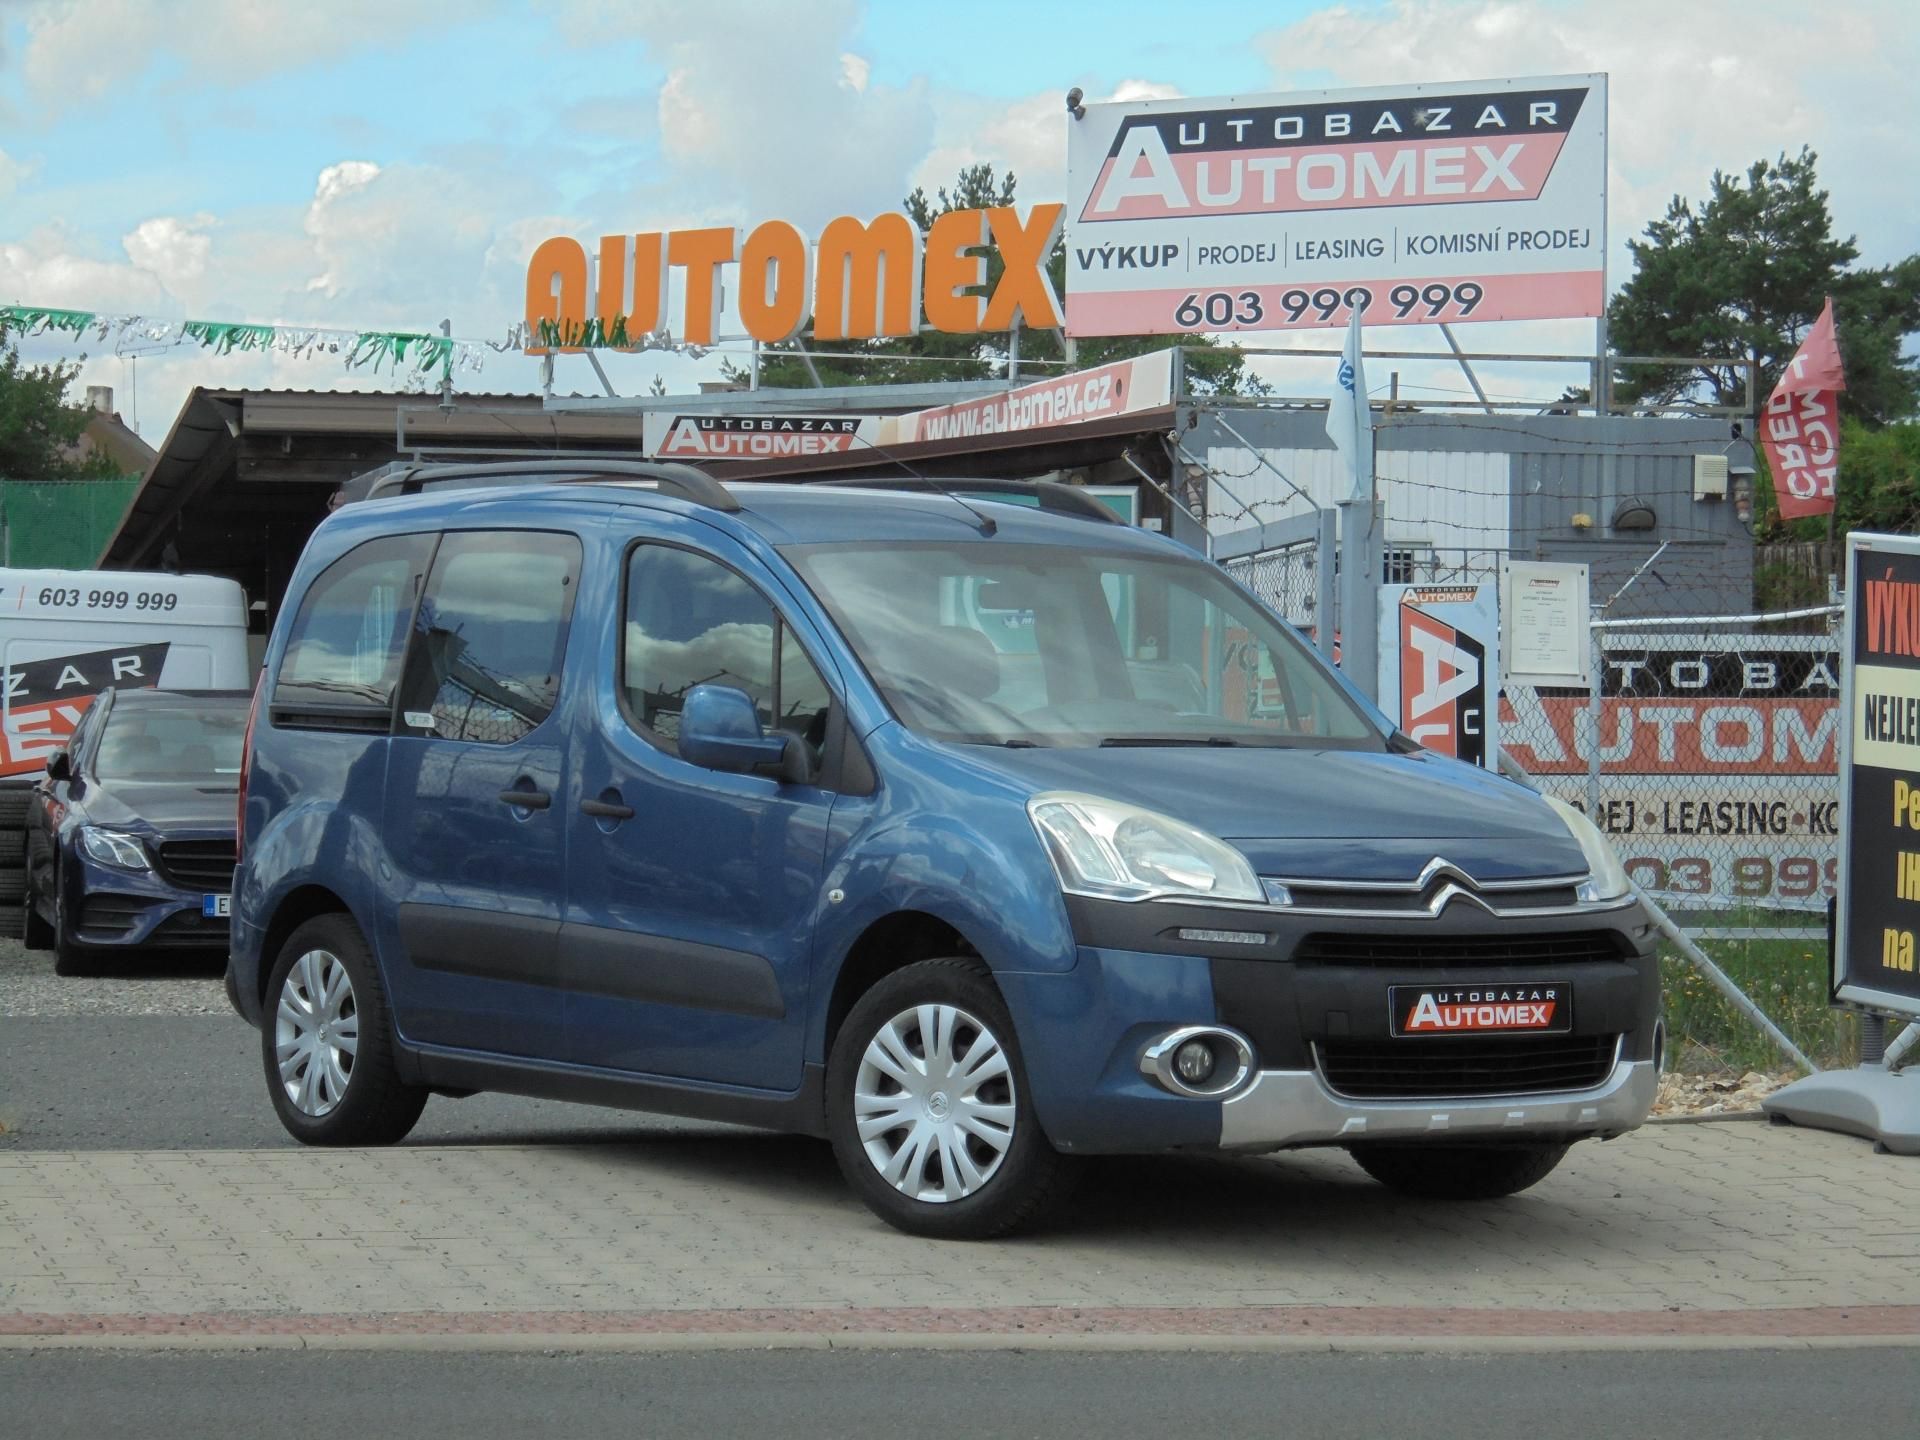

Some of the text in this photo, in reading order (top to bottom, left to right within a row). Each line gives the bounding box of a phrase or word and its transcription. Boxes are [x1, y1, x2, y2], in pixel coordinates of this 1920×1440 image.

[1093, 125, 1526, 213] AUTOMEX
[1076, 227, 1591, 271] VÝKUP PRODEJ LEASING KOMISNÍ PRODEJ
[524, 202, 1065, 356] AUTOMEX
[1175, 283, 1483, 328] 603 999 999
[926, 375, 1111, 441] www.automex.cz
[667, 419, 842, 455] AUTOMEX
[38, 588, 178, 611] 603 999 999
[1402, 588, 1472, 603] AUTOMEX
[1865, 694, 1920, 746] NEJLE
[1664, 801, 1787, 835] LEASING
[1882, 928, 1914, 972] na
[1411, 994, 1547, 1027] AUTOMEX
